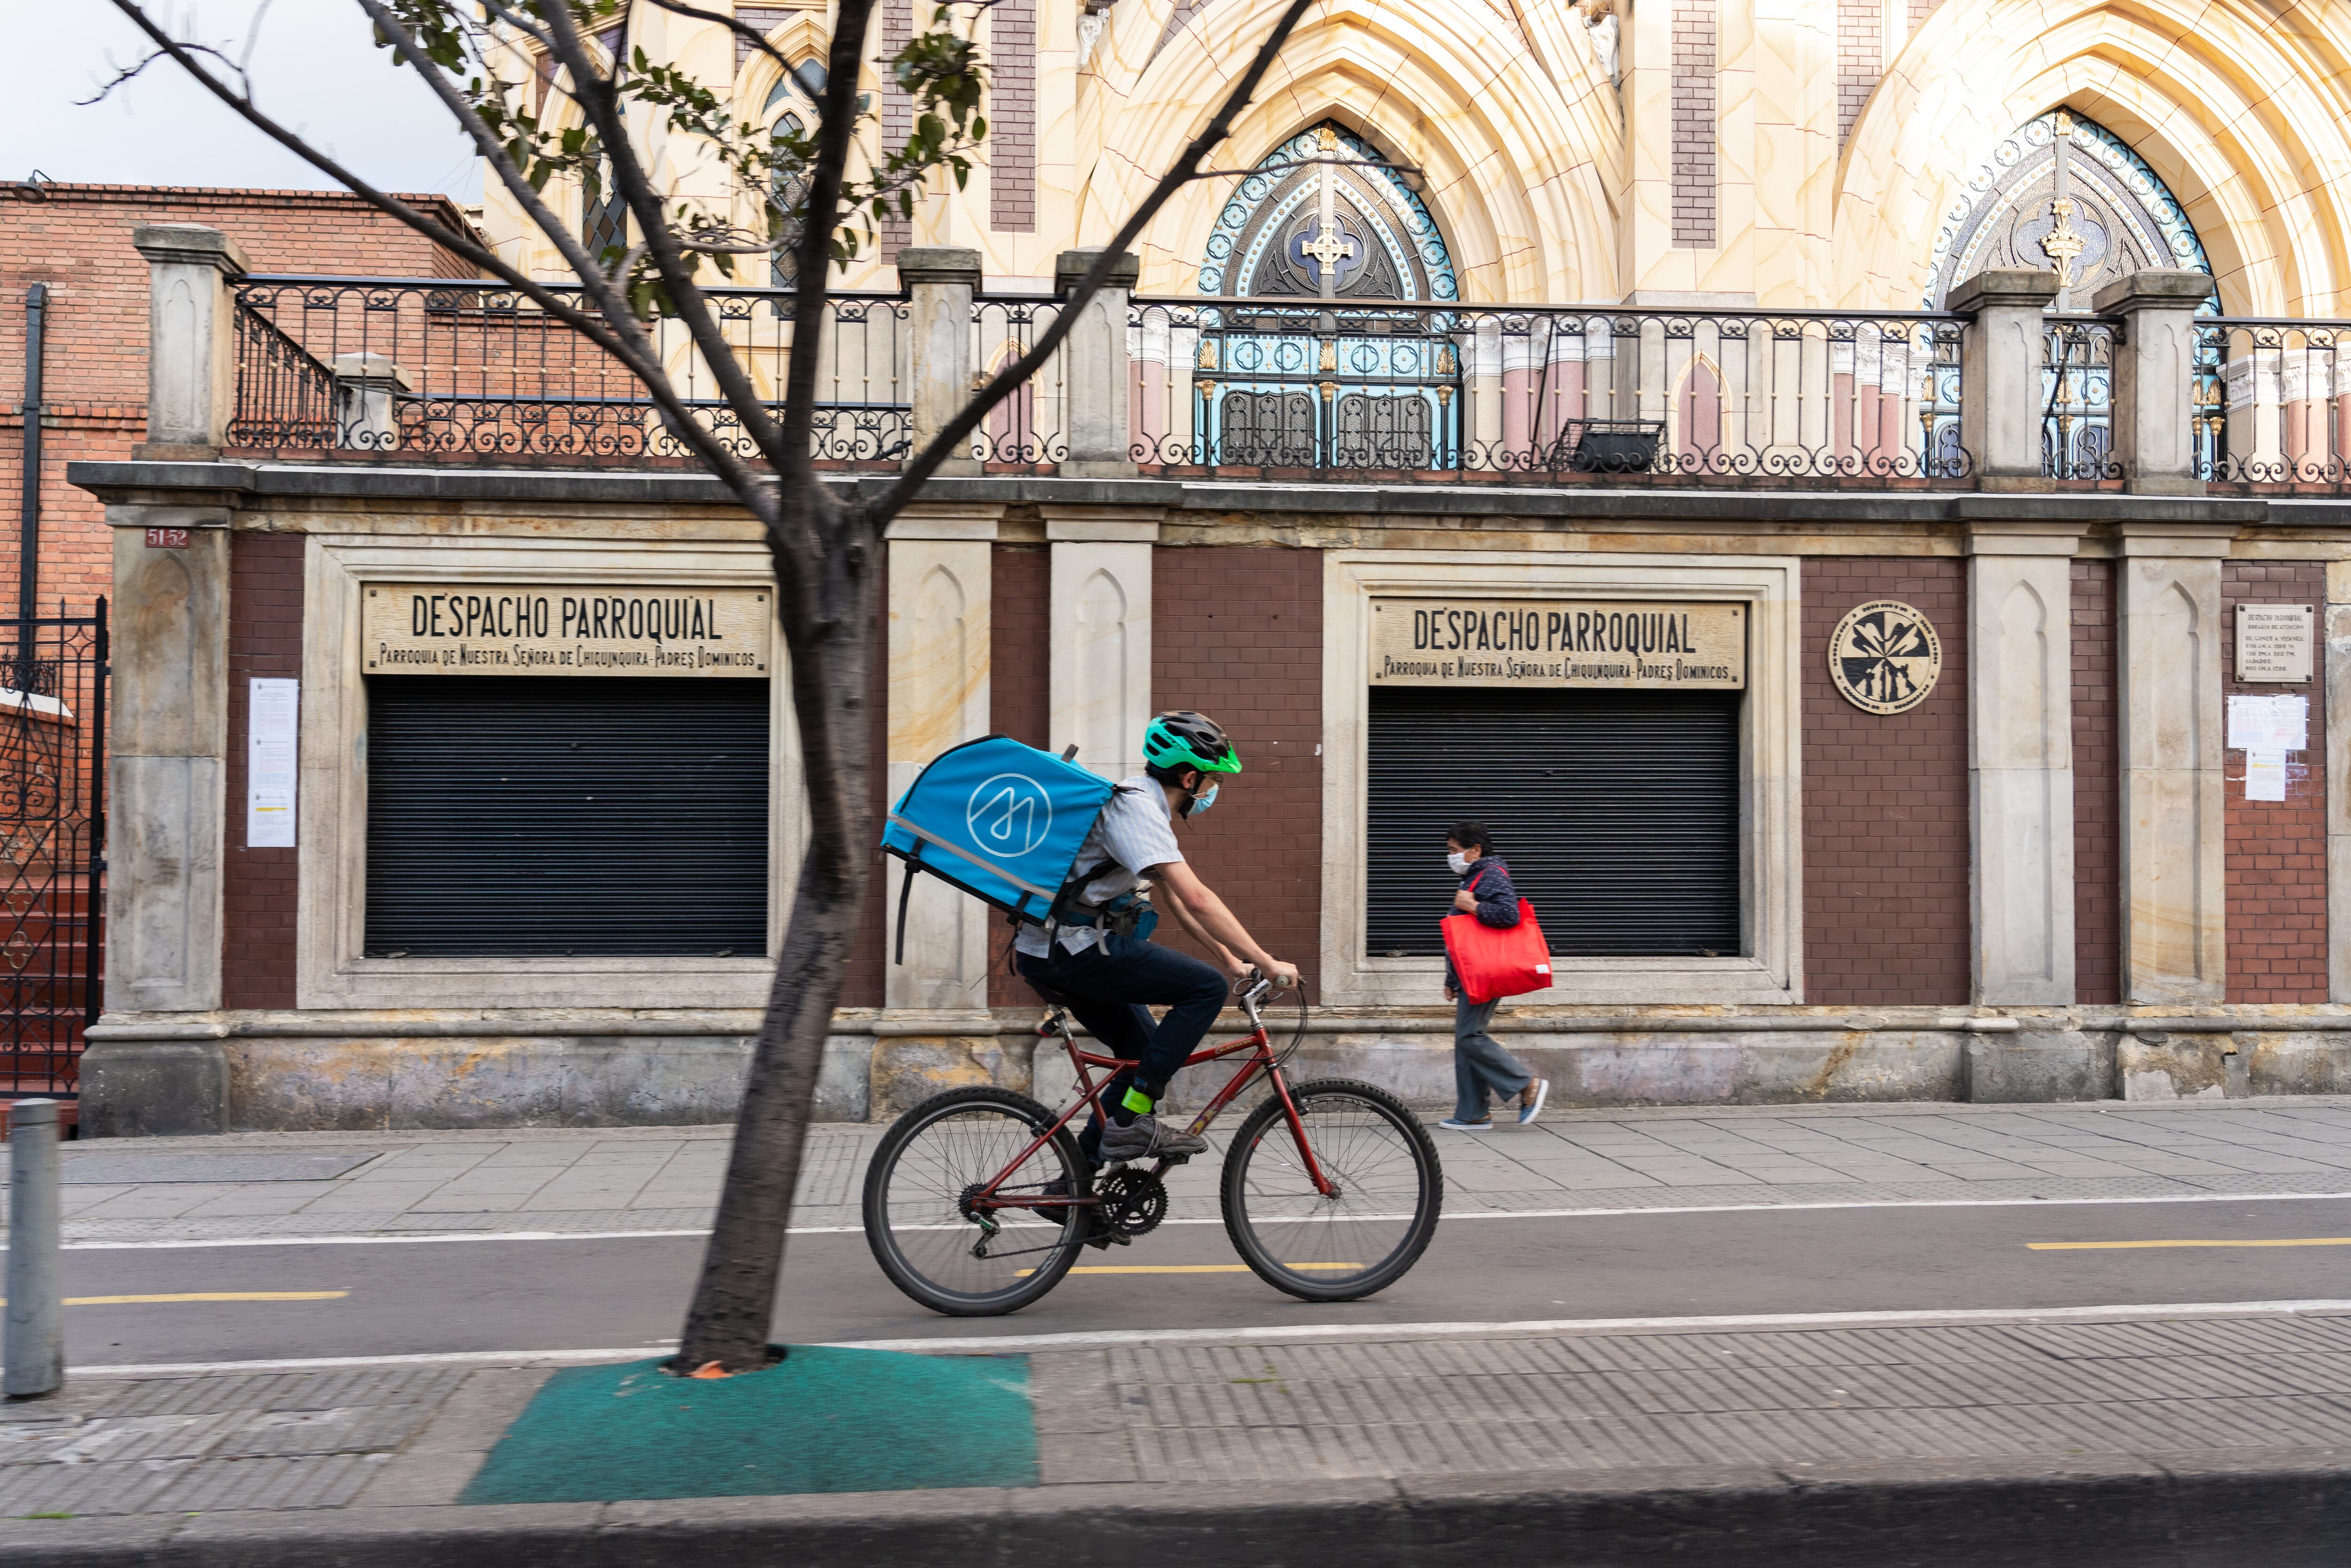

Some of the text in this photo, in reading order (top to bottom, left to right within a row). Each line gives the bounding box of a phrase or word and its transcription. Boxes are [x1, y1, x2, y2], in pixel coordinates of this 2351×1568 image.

[413, 595, 722, 645] DESPACHO PARROQUIAL
[1415, 610, 1696, 657] DESPACHO PARROQUIAL
[380, 642, 438, 665] PARROQUIA
[443, 650, 456, 665] DE
[460, 643, 509, 666] NUESTRA
[513, 644, 555, 667] SEÑORA
[560, 651, 572, 665] DE
[1384, 655, 1438, 677] PARROQUIA
[1442, 662, 1454, 678] DE
[1458, 656, 1503, 678] NUESTRA
[1507, 656, 1545, 678] SEÑORA
[1549, 663, 1562, 677] DE
